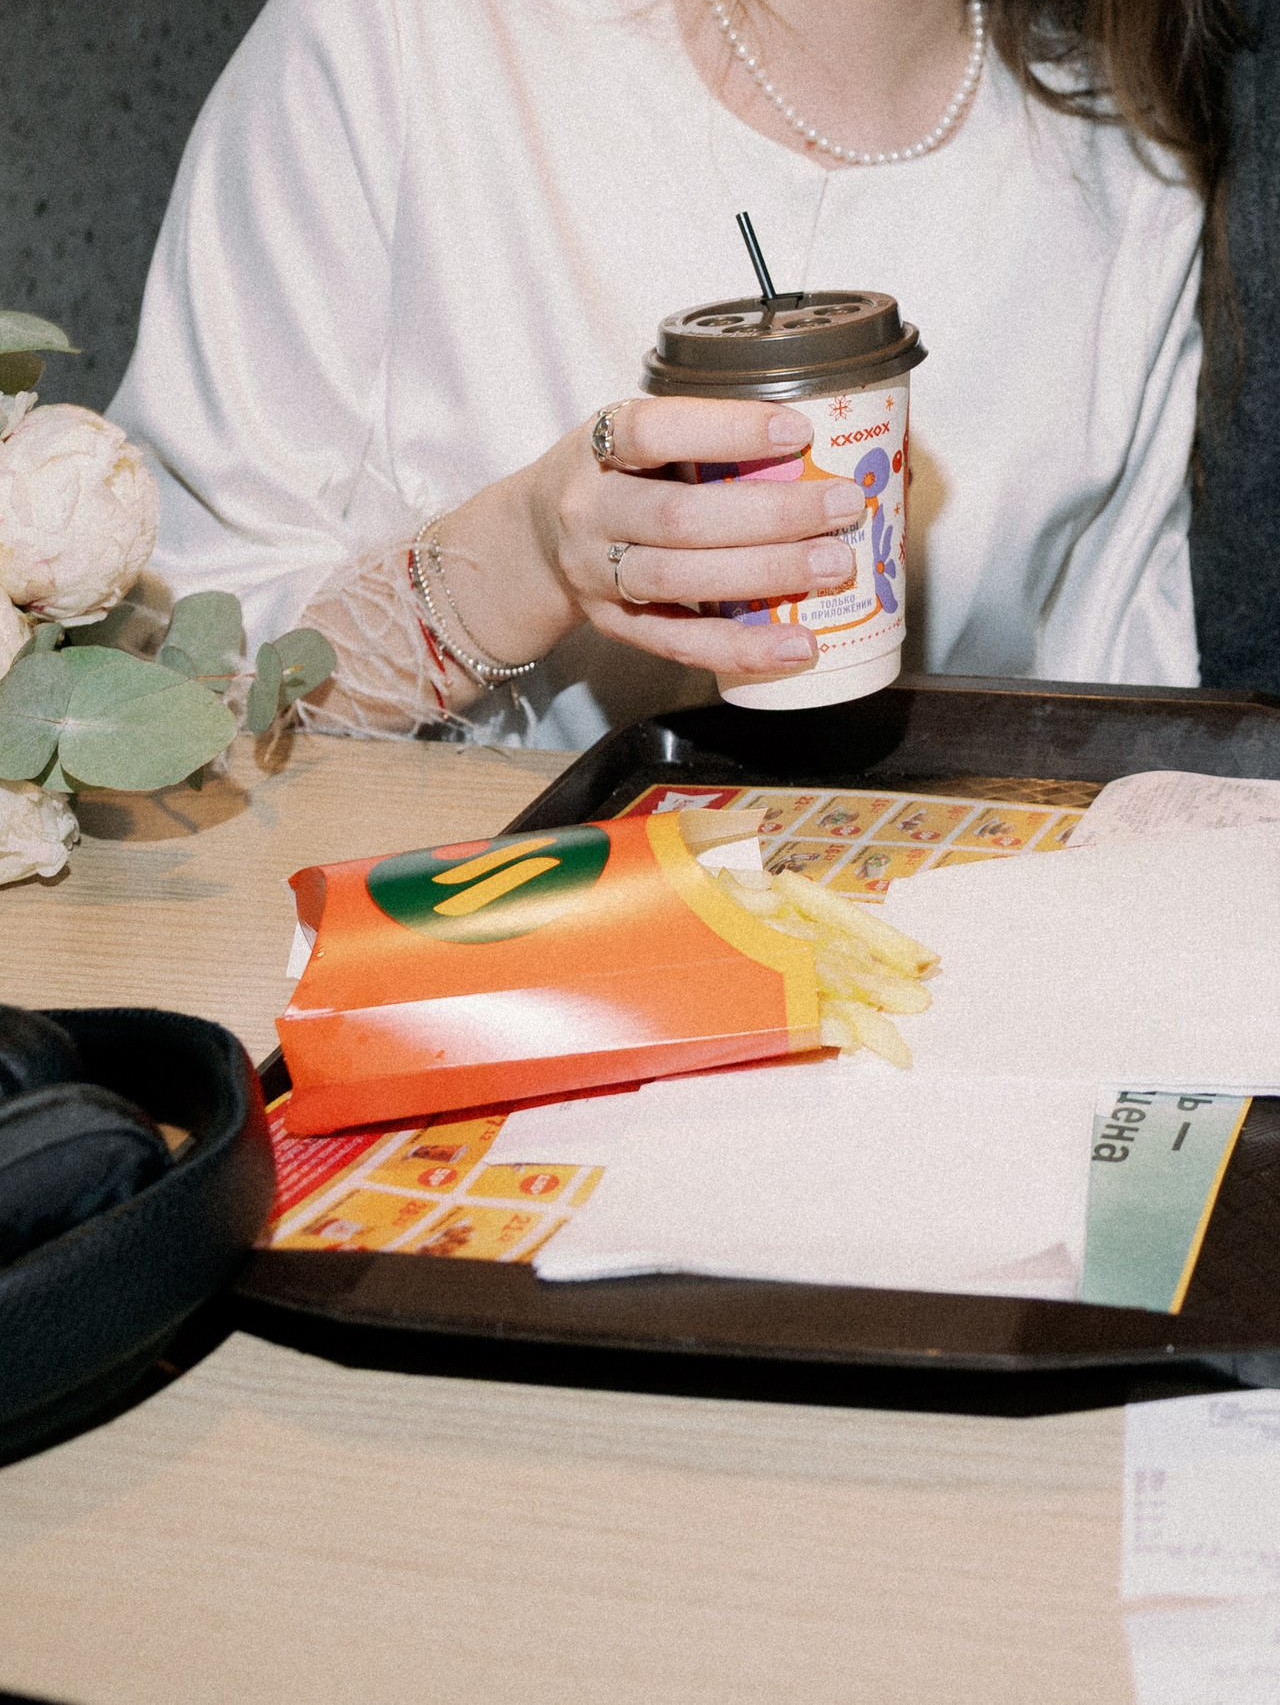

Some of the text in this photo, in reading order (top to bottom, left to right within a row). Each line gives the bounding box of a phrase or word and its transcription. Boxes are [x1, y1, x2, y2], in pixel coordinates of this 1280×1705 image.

[801, 598, 872, 622] В ПРИЛОЖЕНИИ
[820, 594, 855, 609] ТОЛЬКО
